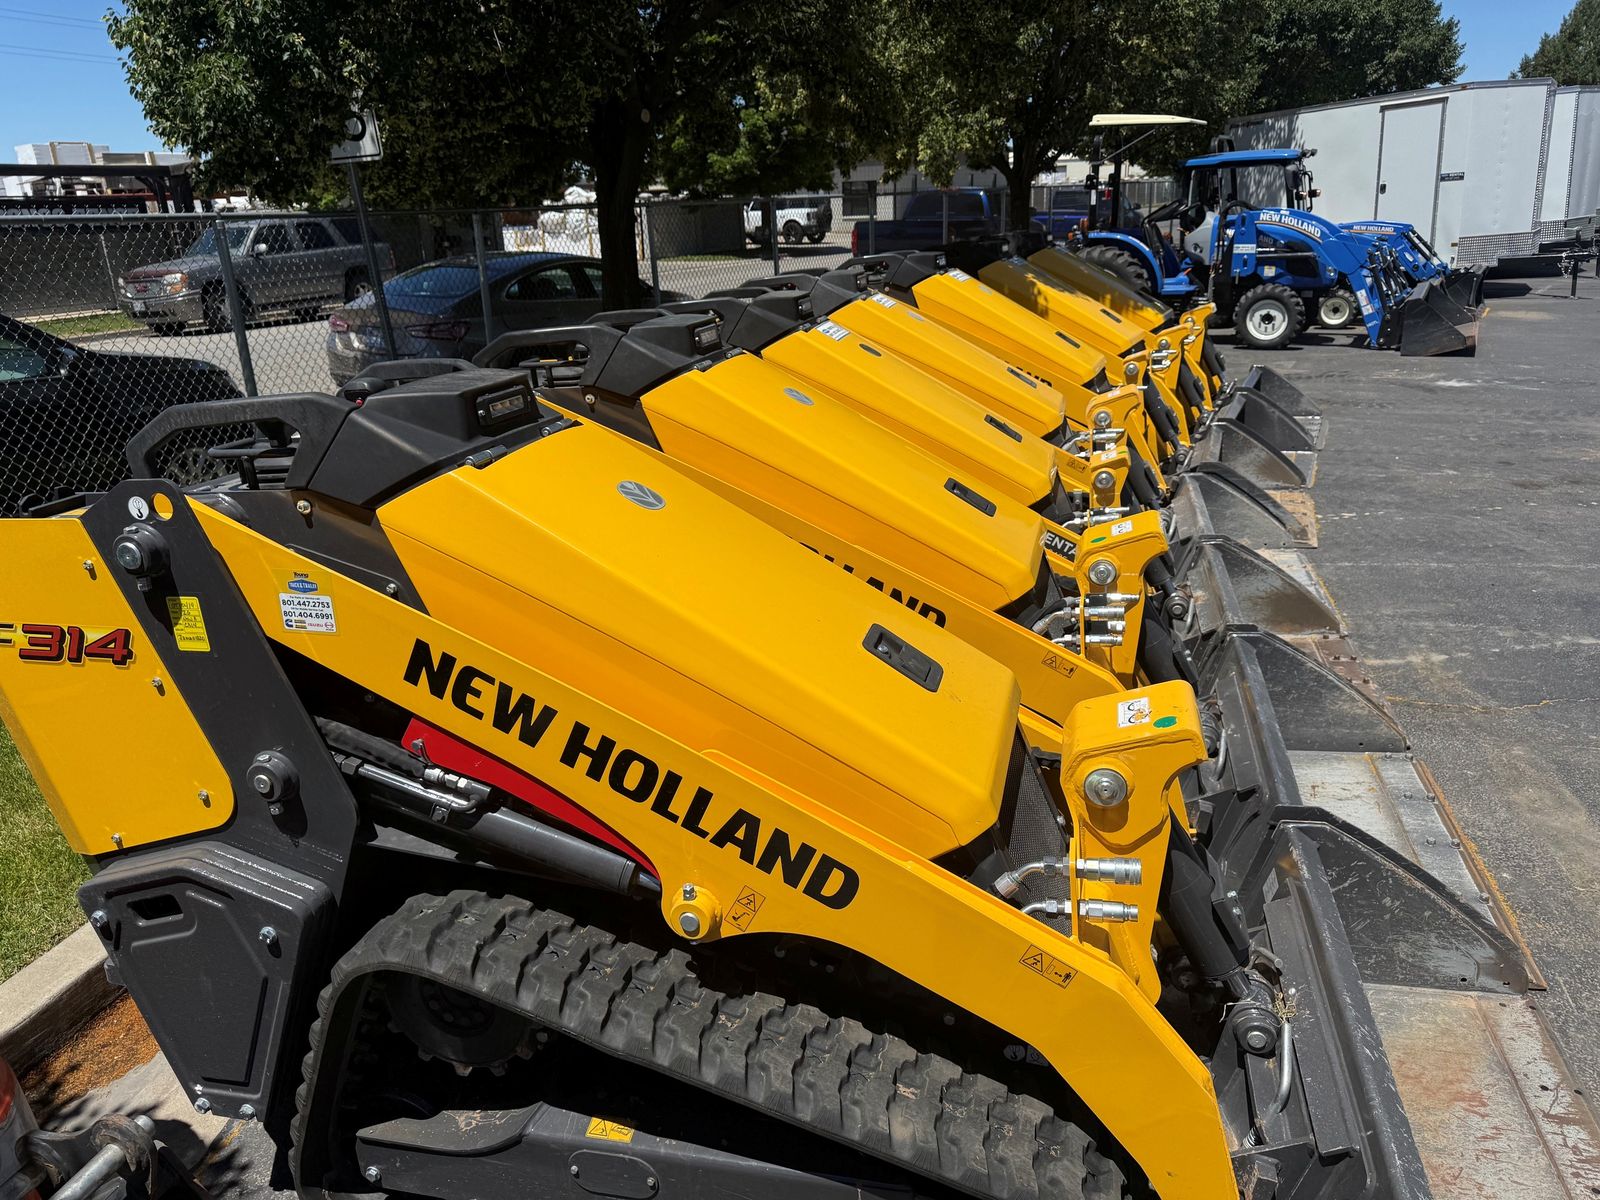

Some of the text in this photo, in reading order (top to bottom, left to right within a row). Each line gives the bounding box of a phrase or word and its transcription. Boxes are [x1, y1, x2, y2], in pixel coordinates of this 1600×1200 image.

[1259, 212, 1321, 238] NEW HOLLAND
[281, 599, 331, 609] 801.447.2753
[283, 610, 333, 620] 801.404.6991
[403, 638, 860, 910] NEW HOLLAND
